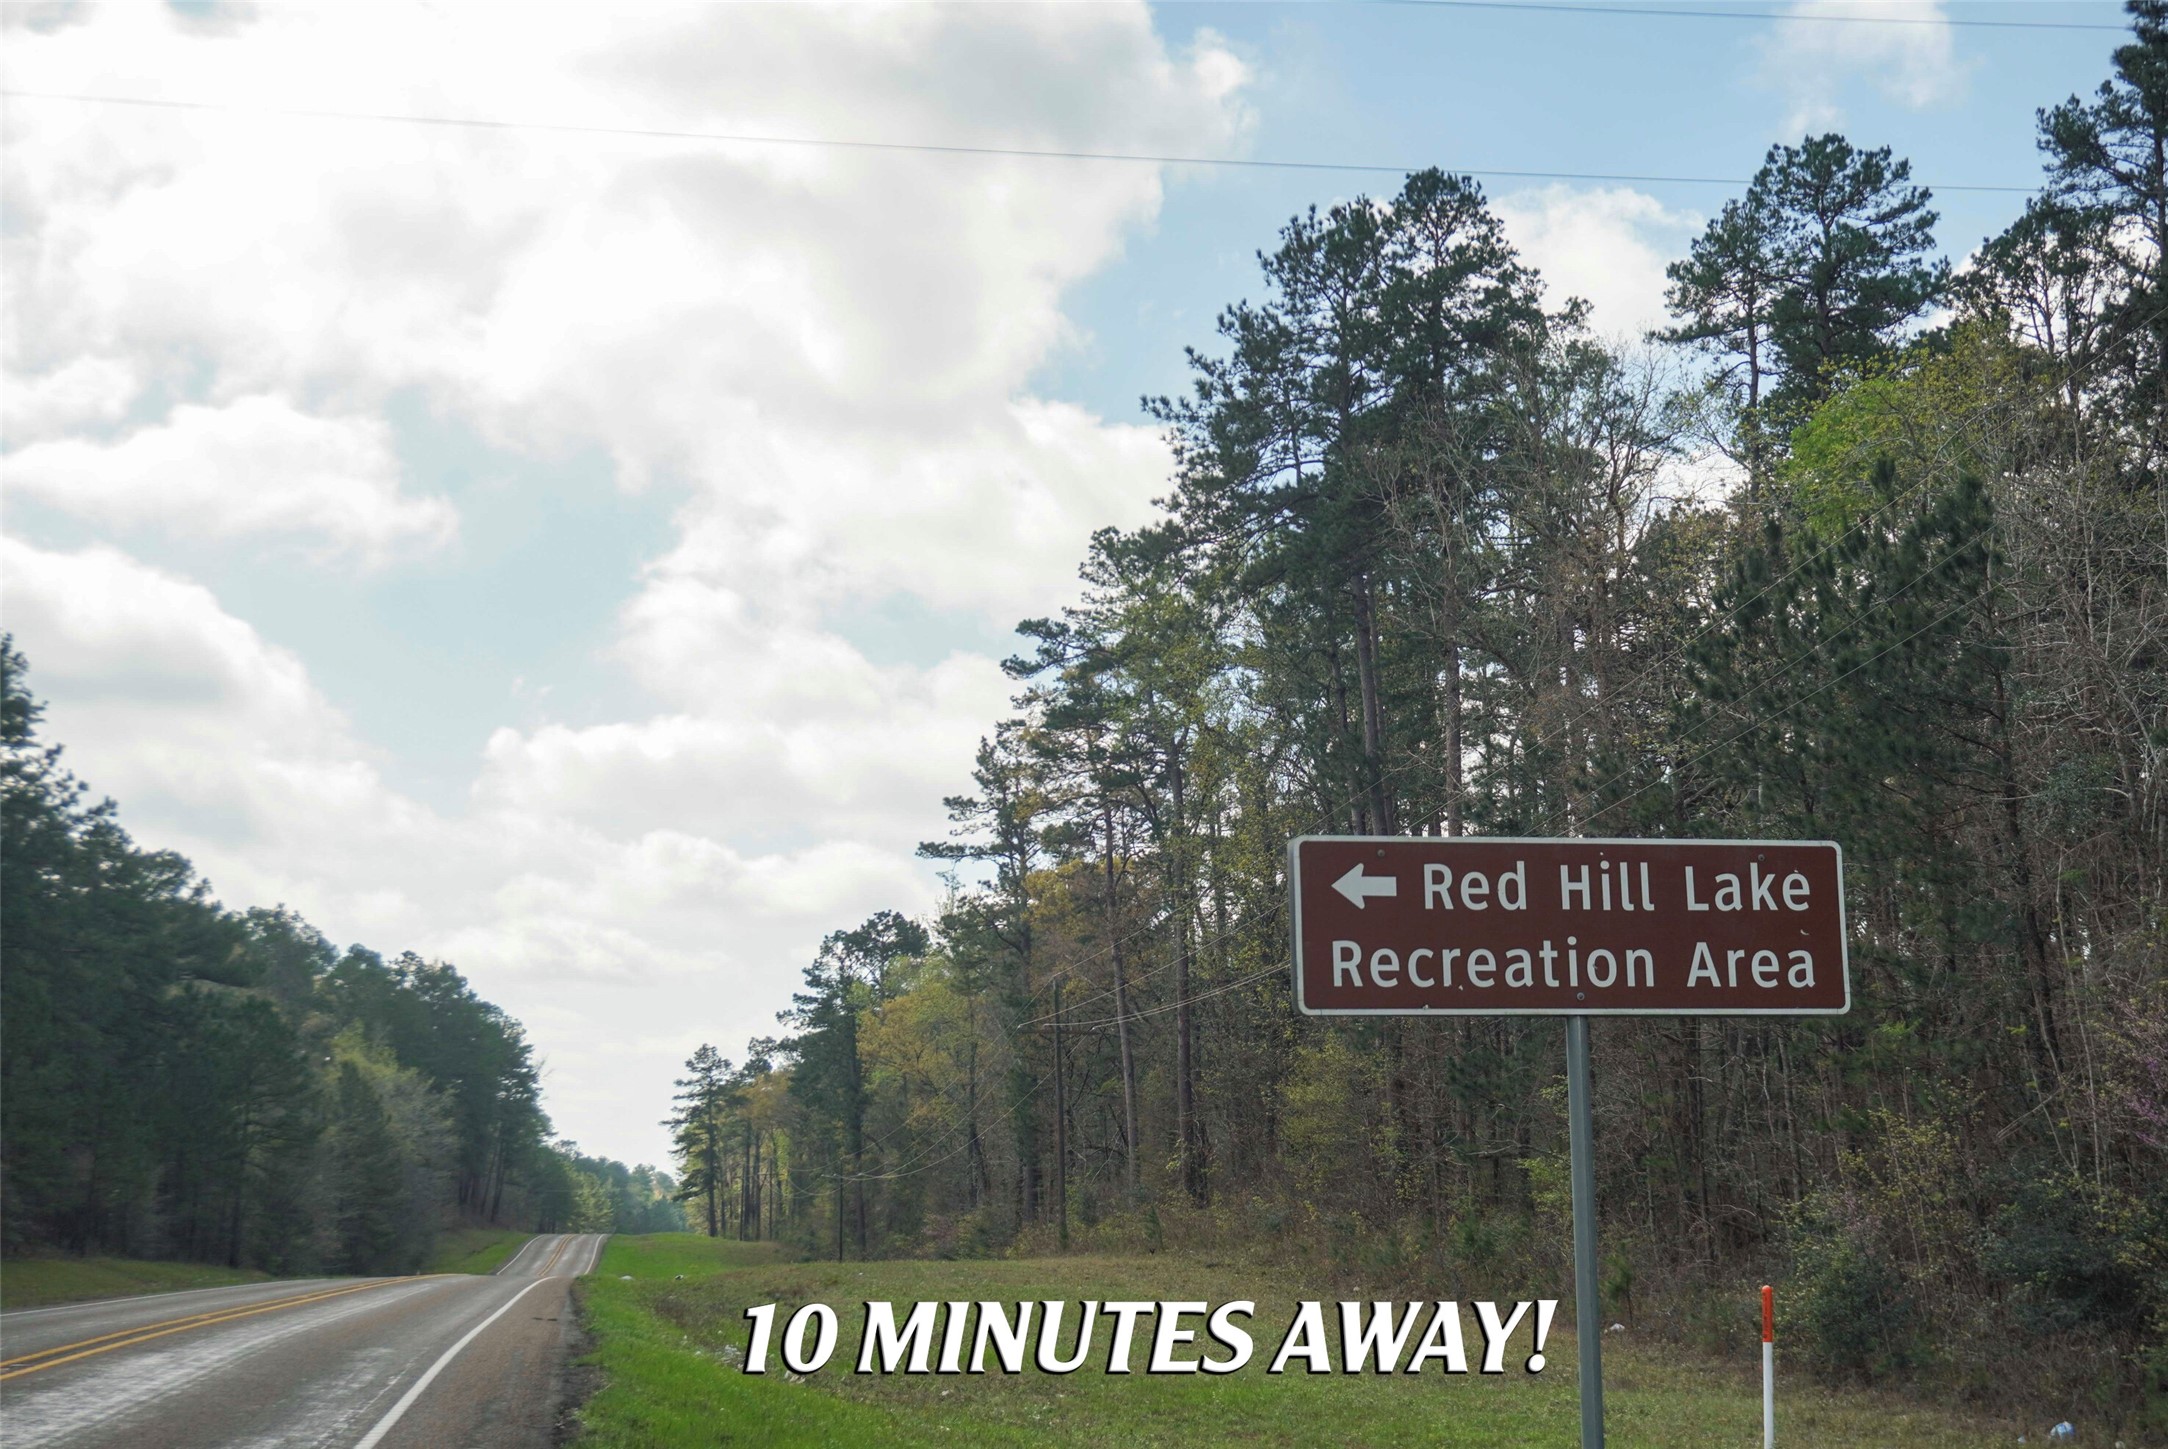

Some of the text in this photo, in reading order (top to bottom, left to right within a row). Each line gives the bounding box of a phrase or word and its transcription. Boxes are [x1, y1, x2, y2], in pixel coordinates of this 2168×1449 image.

[1423, 860, 1811, 912] Red Hill Lake
[1332, 936, 1816, 988] Recreation Area
